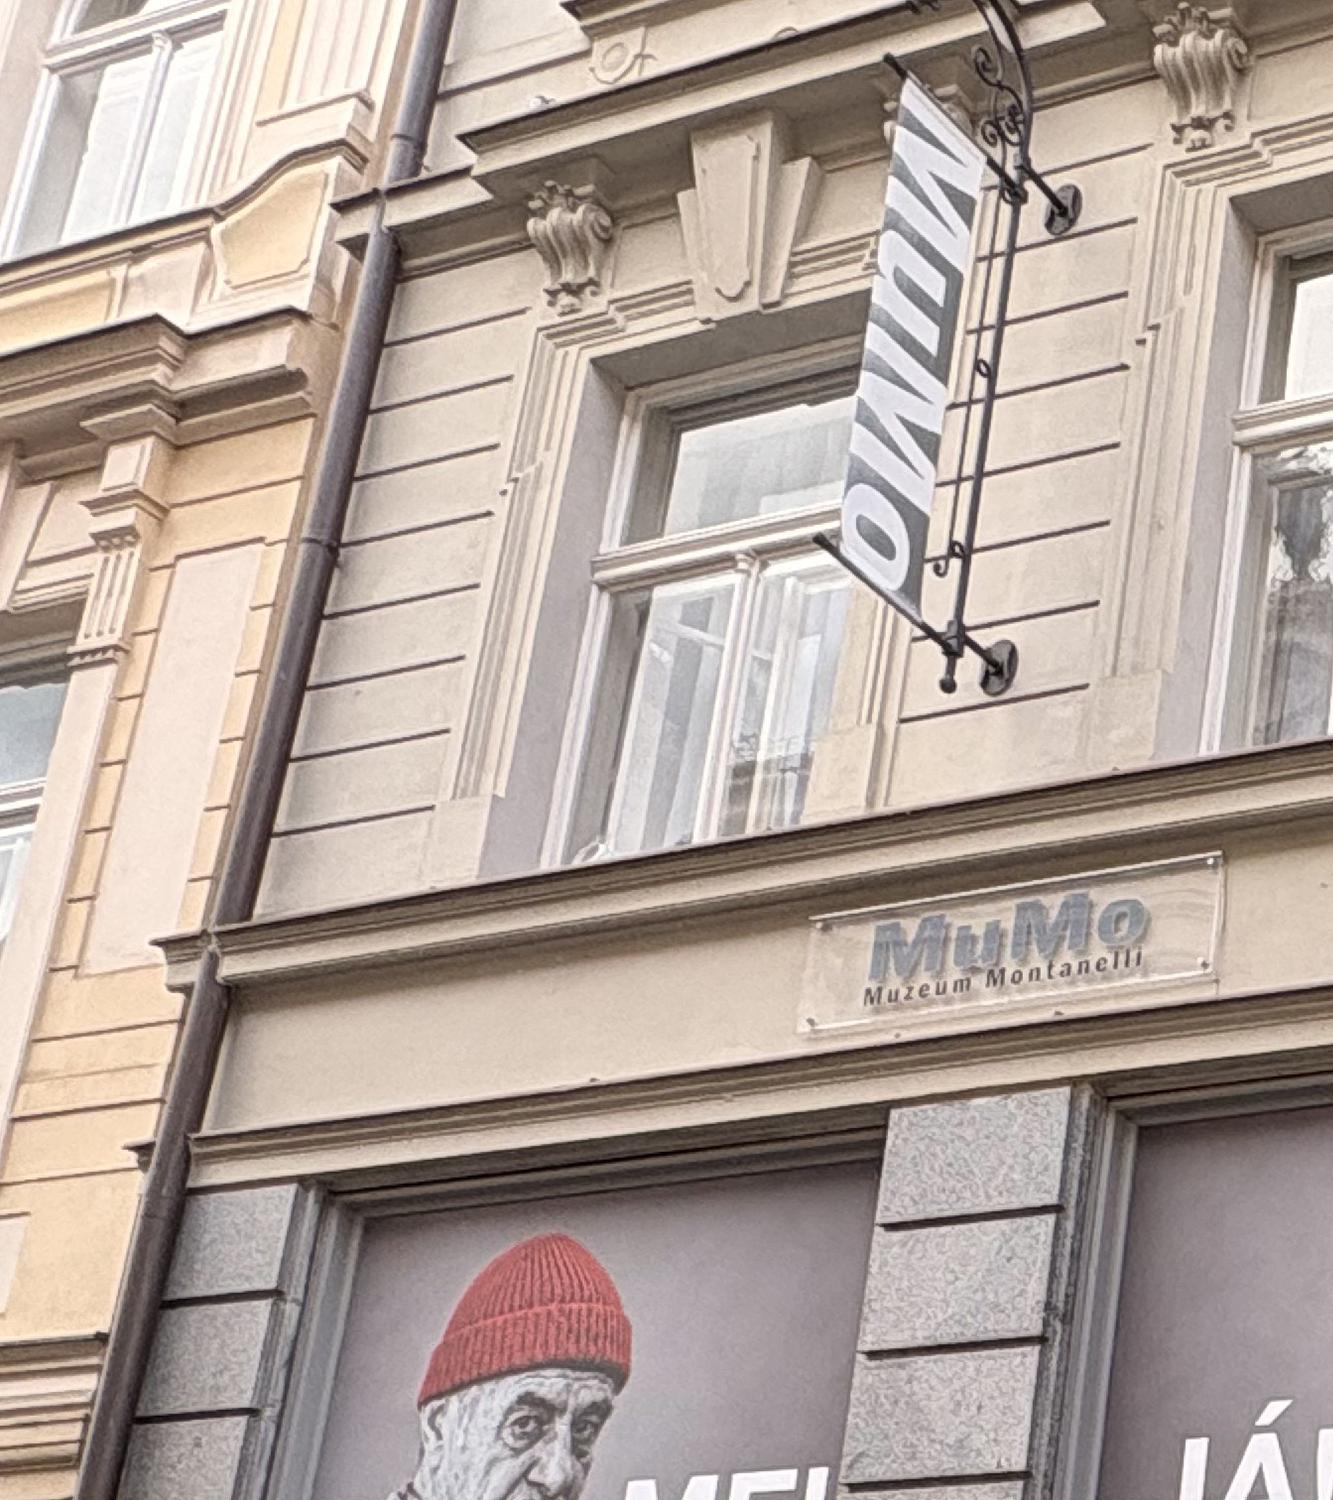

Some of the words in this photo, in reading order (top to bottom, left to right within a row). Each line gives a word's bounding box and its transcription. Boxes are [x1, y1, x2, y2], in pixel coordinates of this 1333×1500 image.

[842, 80, 987, 592] MuMo
[862, 974, 972, 1006] Muzeum
[985, 946, 1145, 988] Montanelli
[867, 890, 1150, 984] MuMo
